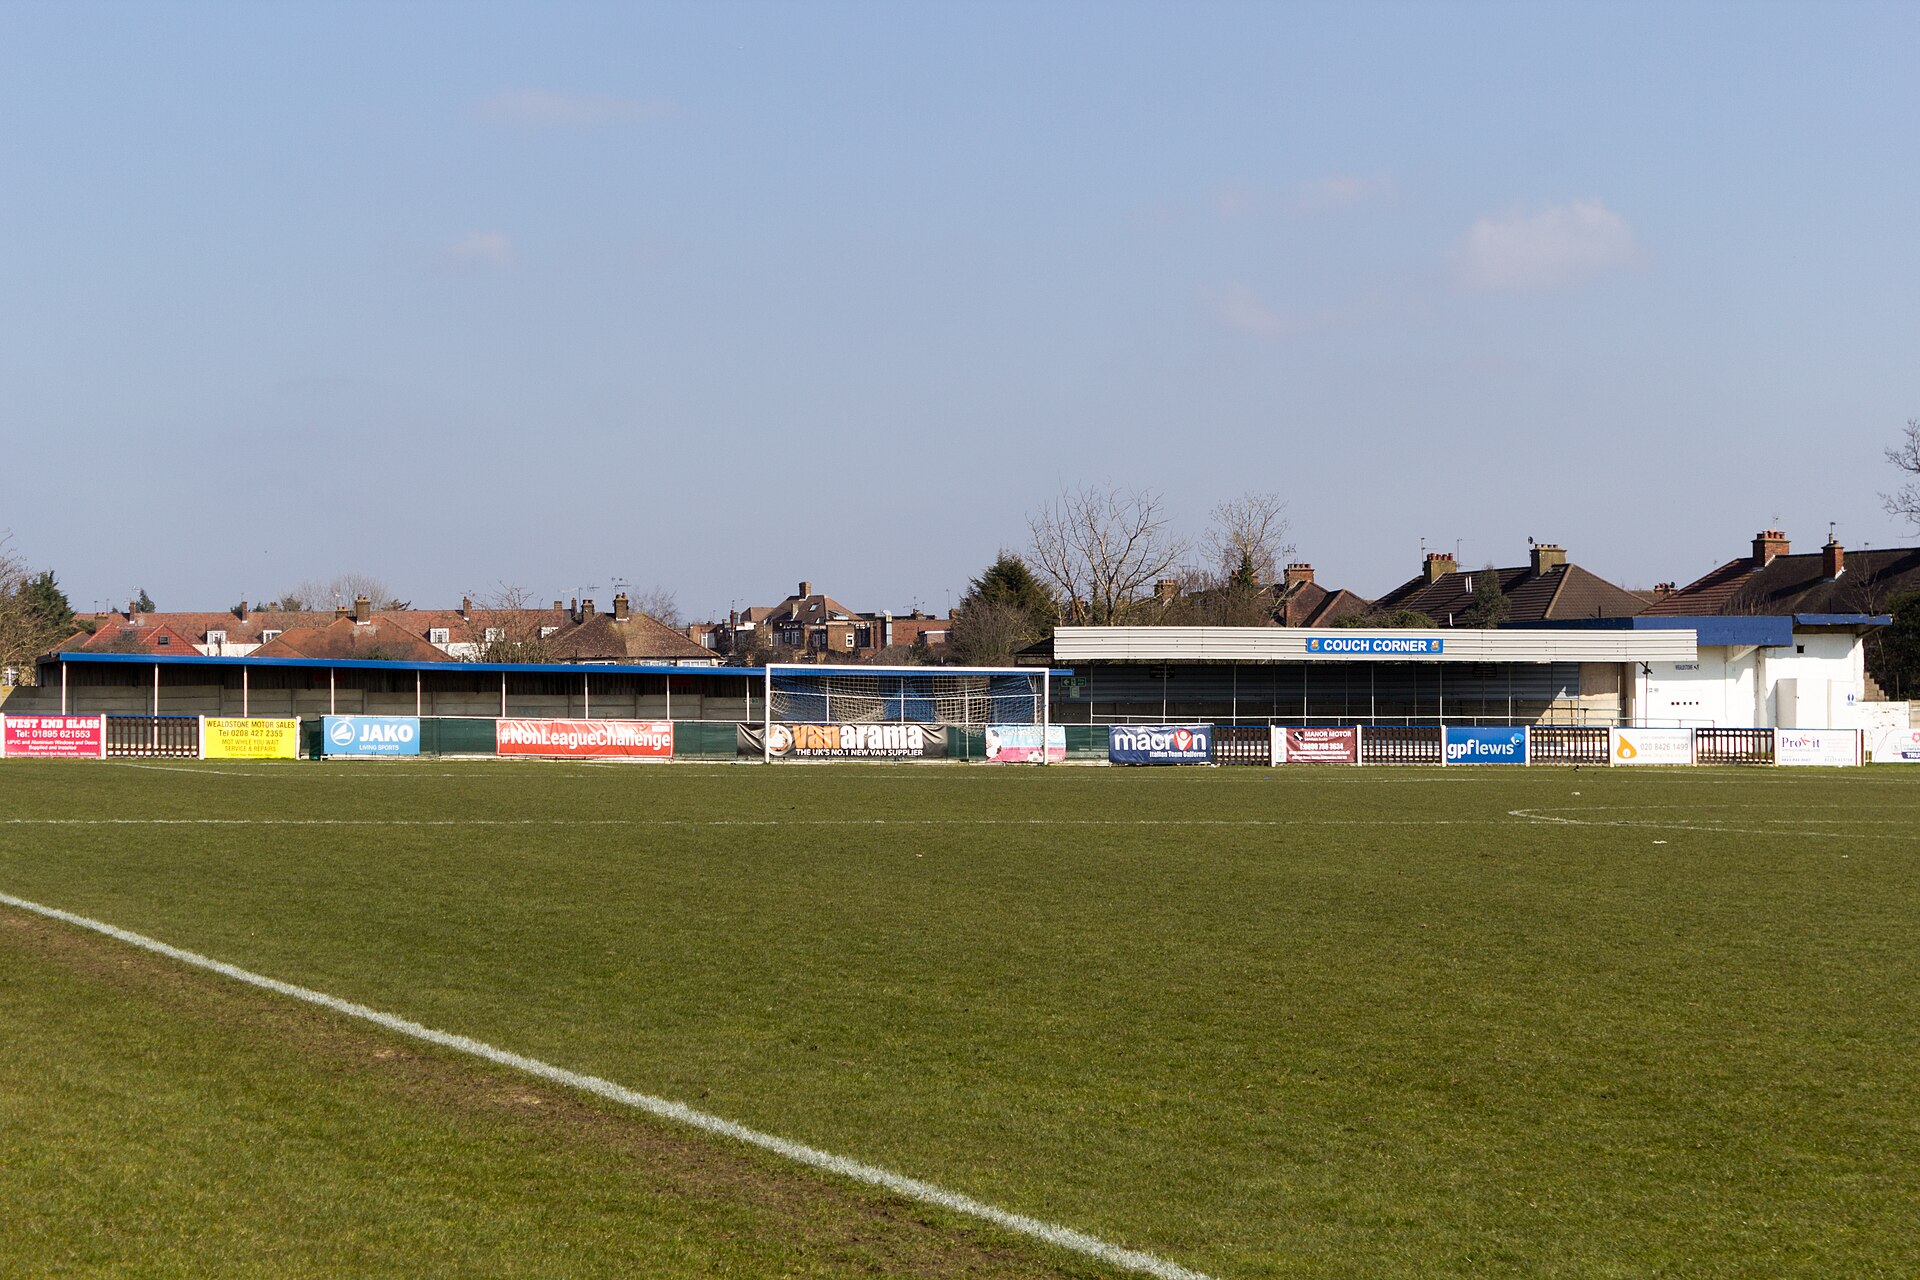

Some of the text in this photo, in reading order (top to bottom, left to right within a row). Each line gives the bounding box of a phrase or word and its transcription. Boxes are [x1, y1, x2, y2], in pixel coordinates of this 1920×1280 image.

[1323, 639, 1427, 652] COUCH CORNER
[6, 719, 100, 729] WEST END GLASS
[206, 720, 249, 728] WEALDSTONE
[276, 721, 295, 729] SALES
[15, 730, 90, 738] Tel: 01895 621553
[219, 729, 229, 737] Tel
[231, 729, 249, 737] 0208
[265, 730, 283, 738] 2355
[359, 724, 414, 743] JAKO
[500, 726, 671, 750] #NonLeagueChallenge
[791, 724, 924, 750] vanarama
[1114, 729, 1207, 751] macron
[1640, 743, 1689, 751] 020 8426 1499
[796, 748, 923, 757] THE UK'S NO.1 NEW VAN SUPPLIER
[1149, 750, 1167, 758] Italian
[1168, 750, 1183, 758] Team
